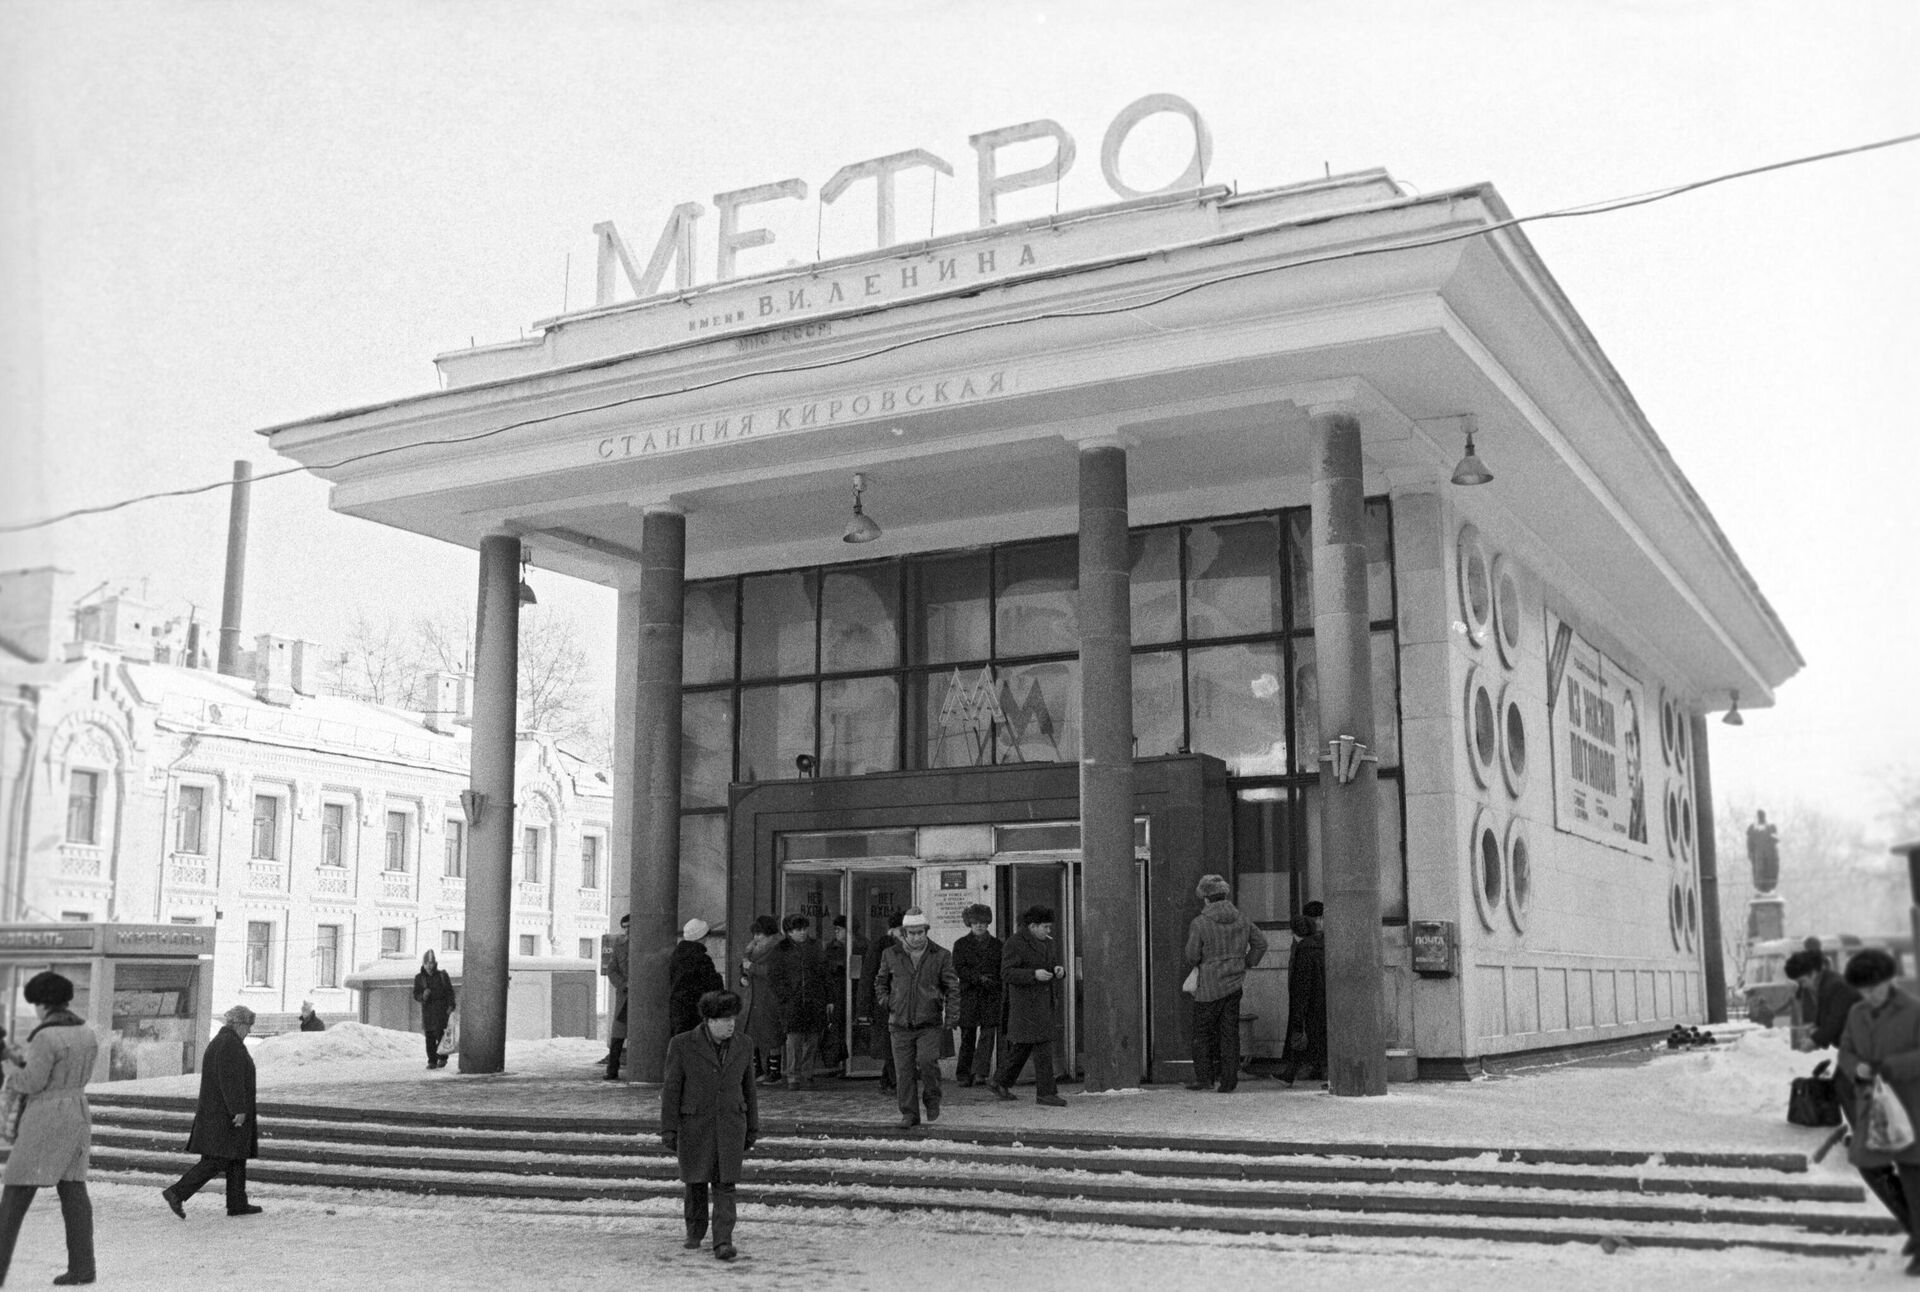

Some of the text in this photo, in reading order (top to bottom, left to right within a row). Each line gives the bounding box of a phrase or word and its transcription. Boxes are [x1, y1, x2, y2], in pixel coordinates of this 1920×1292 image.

[592, 92, 1214, 306] МЕТРО
[829, 243, 1036, 303] ЛЕНИНА
[598, 371, 1006, 458] СТАНЦИЯ КИРОВСКАЯ
[878, 893, 894, 904] НЕТ
[1415, 936, 1445, 945] ПОЧТА
